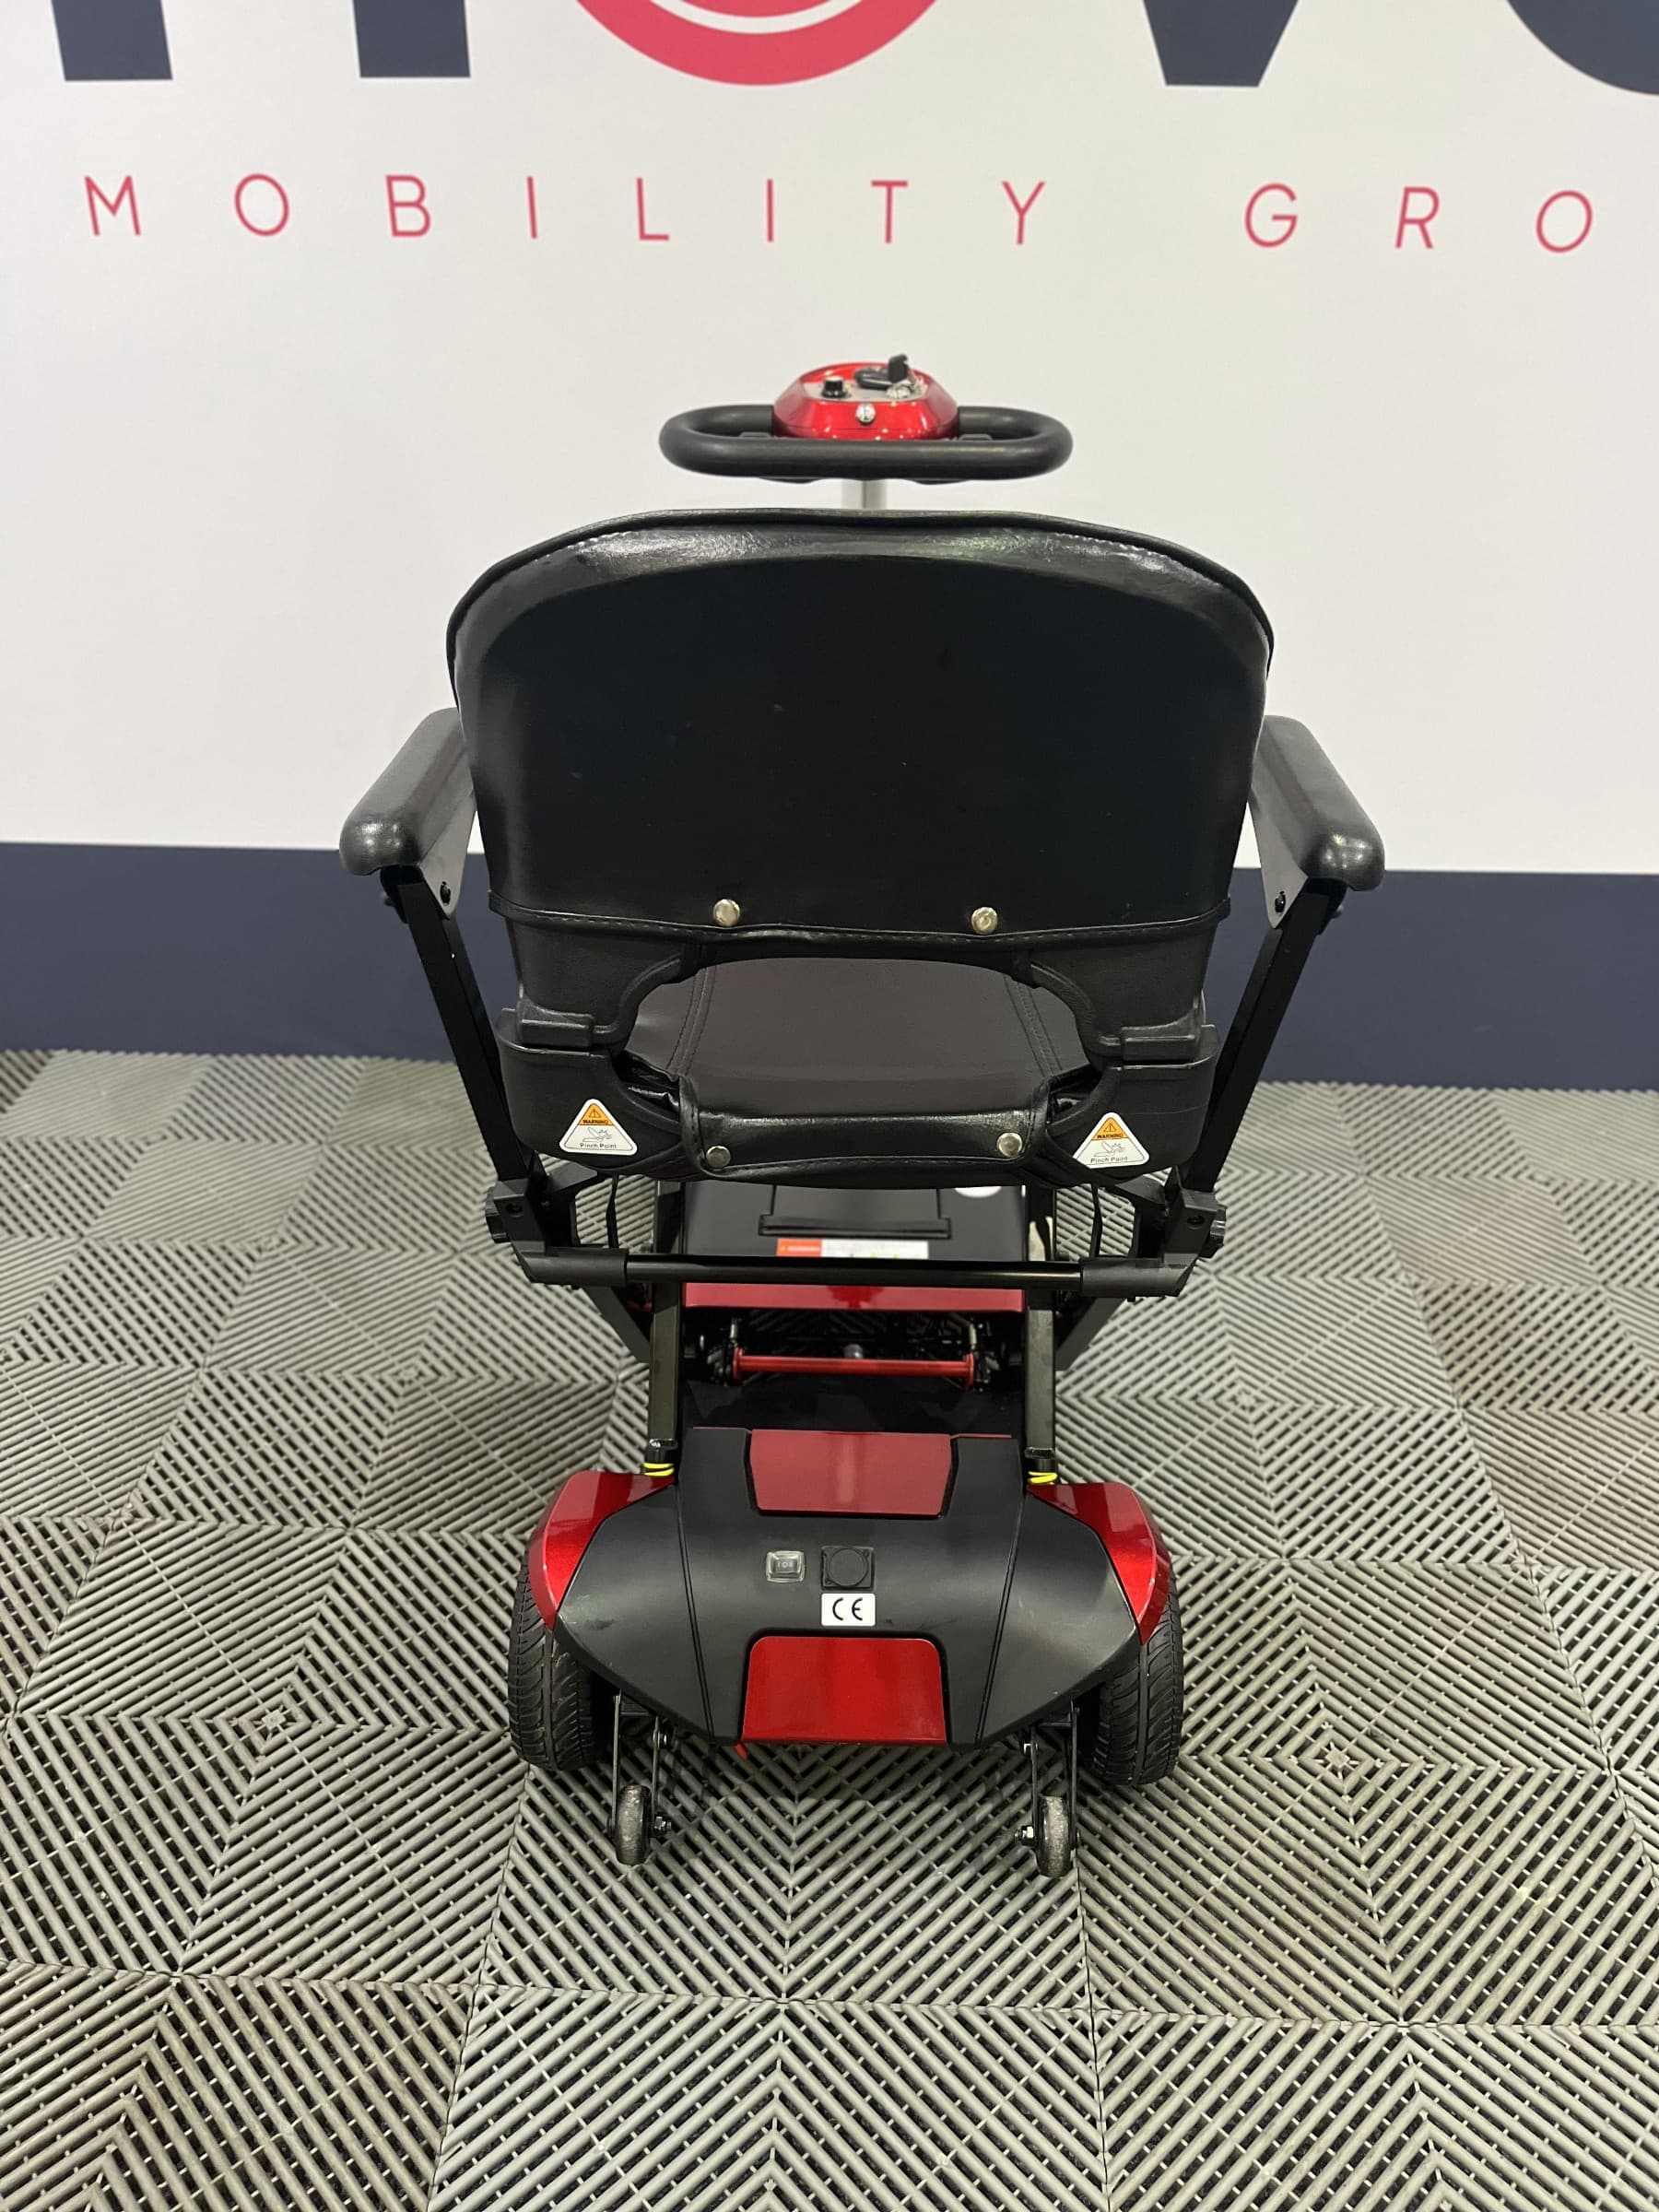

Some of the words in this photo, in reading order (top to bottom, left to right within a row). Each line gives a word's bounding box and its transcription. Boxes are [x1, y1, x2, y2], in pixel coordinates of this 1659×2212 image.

[84, 172, 1044, 245] MOBILITY
[1243, 182, 1594, 254] GRO
[832, 1597, 863, 1620] CE
